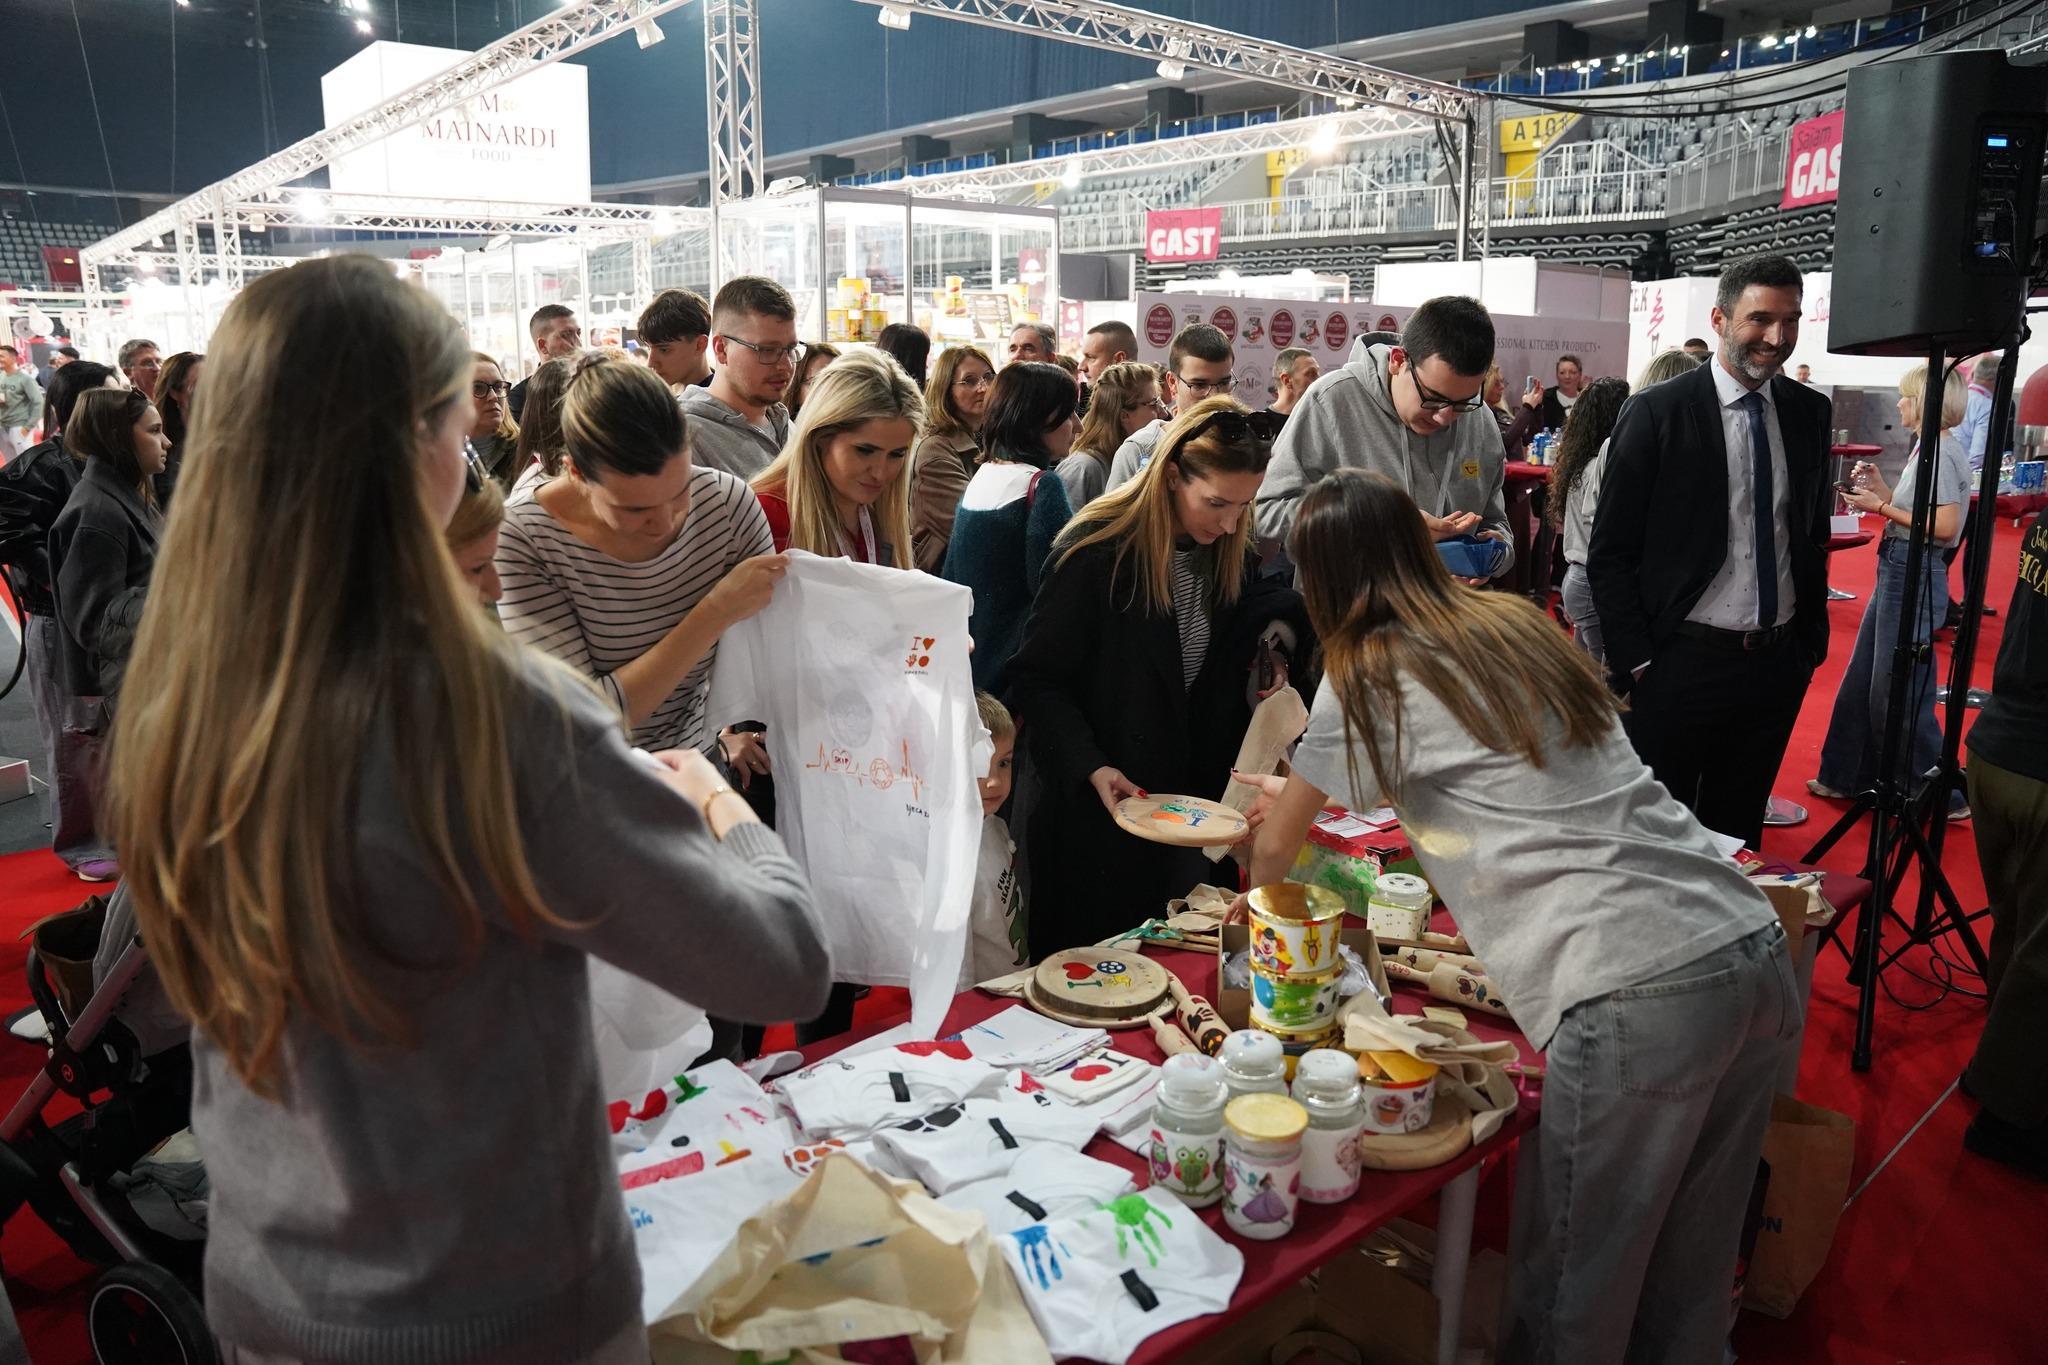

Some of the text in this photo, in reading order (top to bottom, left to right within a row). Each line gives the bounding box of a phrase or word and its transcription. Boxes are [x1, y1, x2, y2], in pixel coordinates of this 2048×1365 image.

[421, 118, 556, 149] MAINARDI
[1513, 121, 1526, 141] A
[471, 148, 511, 162] FOOD
[1150, 226, 1216, 256] GAST
[1529, 339, 1559, 351] KITCHEN
